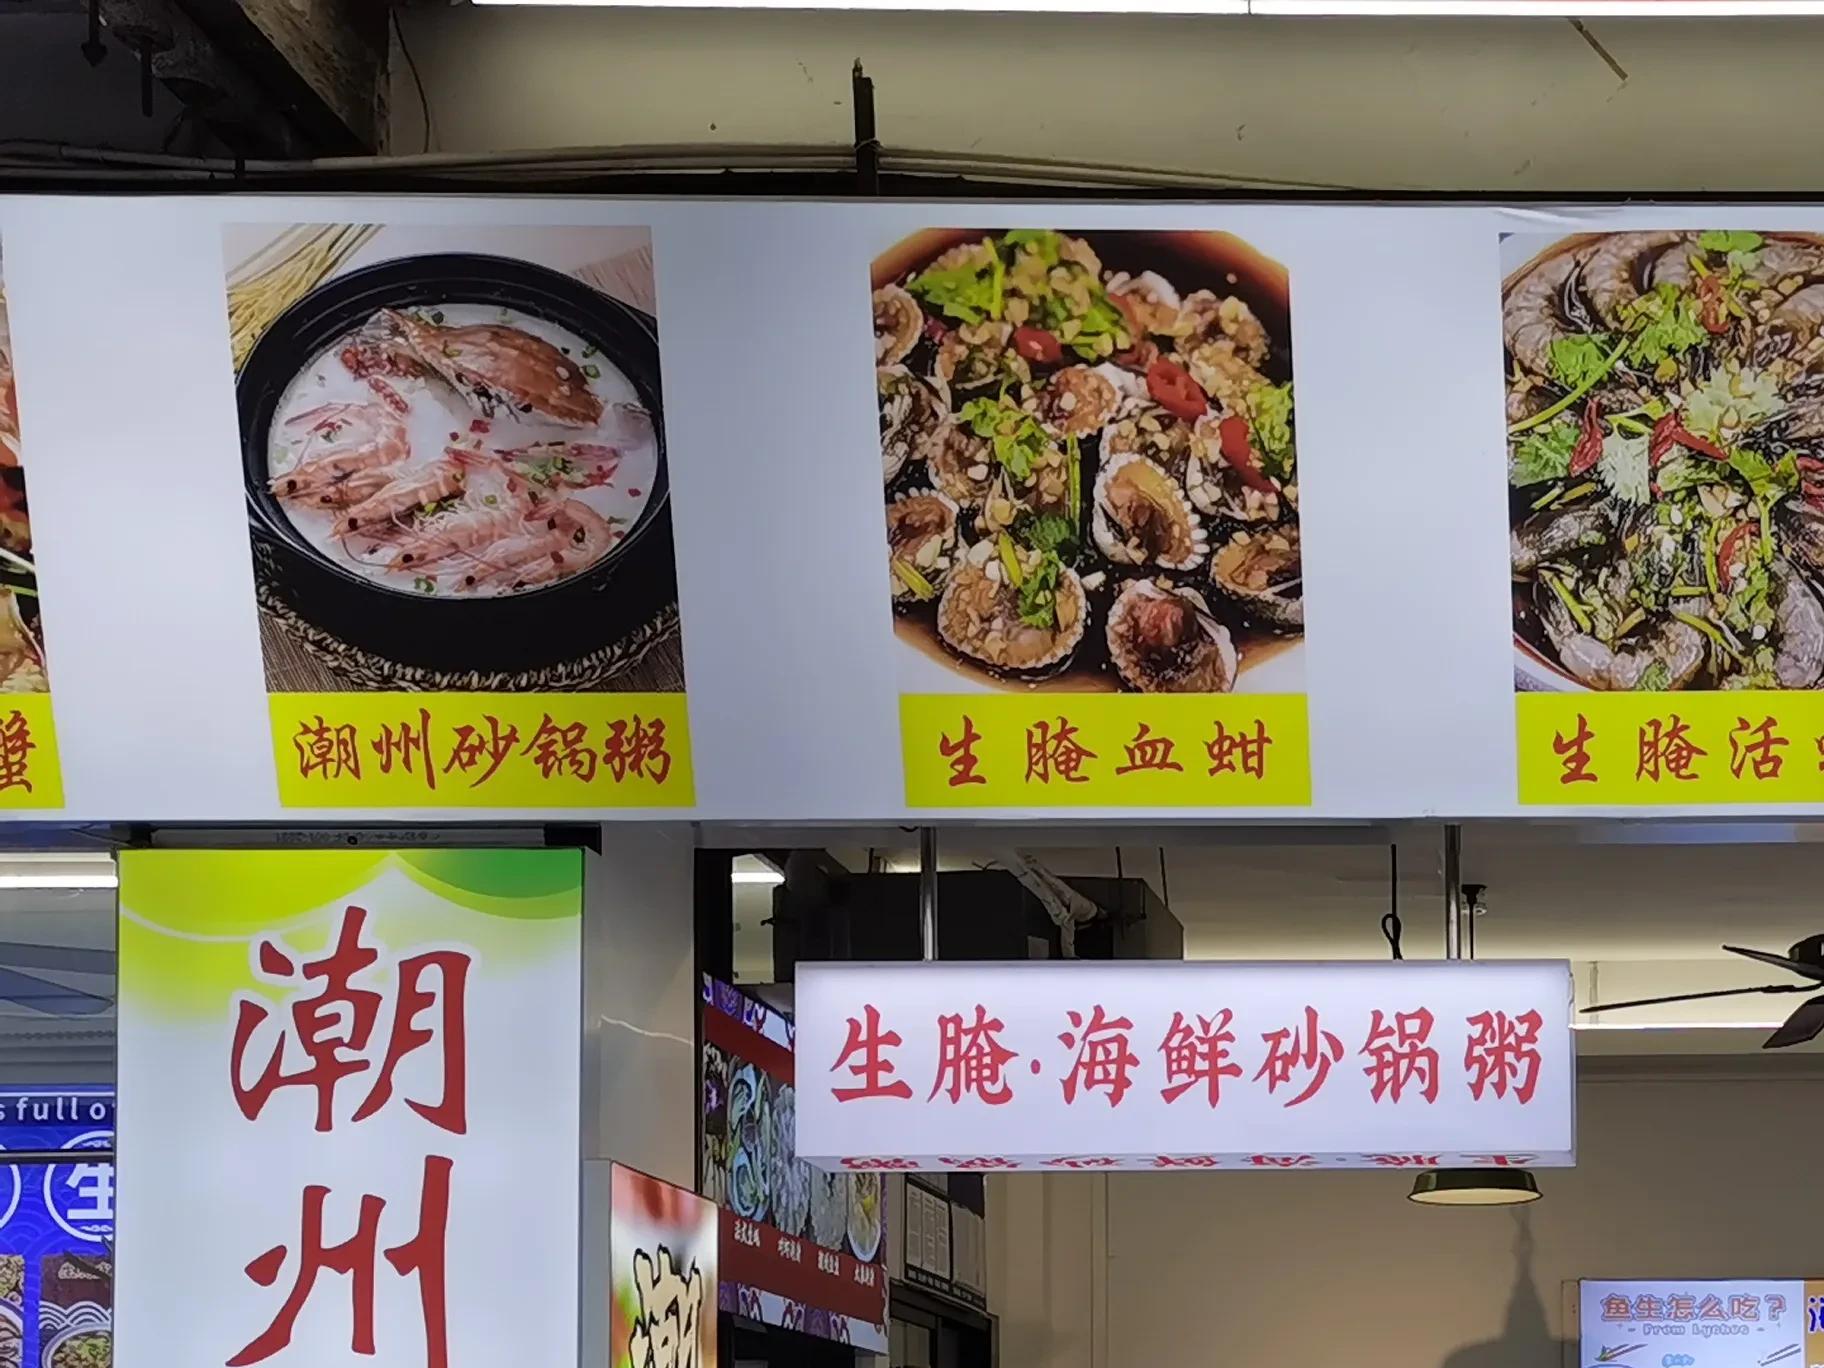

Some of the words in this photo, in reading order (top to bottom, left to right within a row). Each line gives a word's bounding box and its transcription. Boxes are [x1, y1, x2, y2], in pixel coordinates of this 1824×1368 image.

[296, 708, 672, 789] 潮州砂锅粥
[937, 715, 1274, 788] 生腌血蚶
[830, 1003, 1545, 1109] 生腌·海鲜砂锅粥
[16, 1097, 78, 1120] full
[89, 1102, 115, 1120] o
